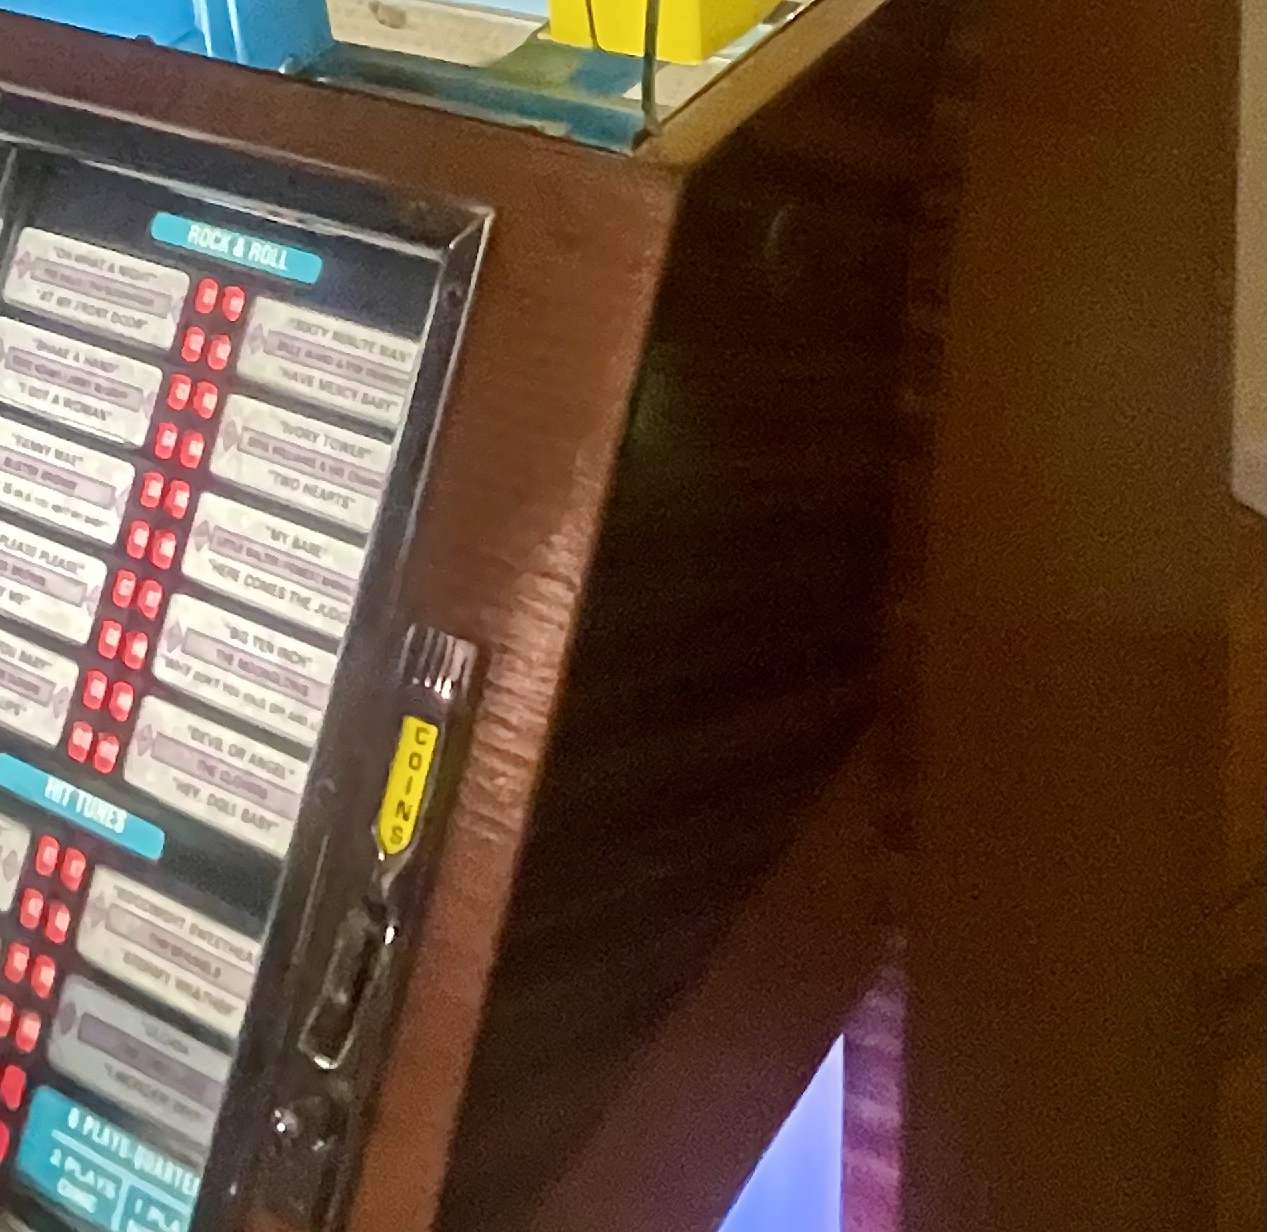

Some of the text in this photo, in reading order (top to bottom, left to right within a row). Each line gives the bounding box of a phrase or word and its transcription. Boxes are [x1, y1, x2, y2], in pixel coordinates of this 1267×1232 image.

[187, 223, 232, 254] ROCK
[247, 242, 289, 271] ROLL
[389, 726, 430, 846] COINS
